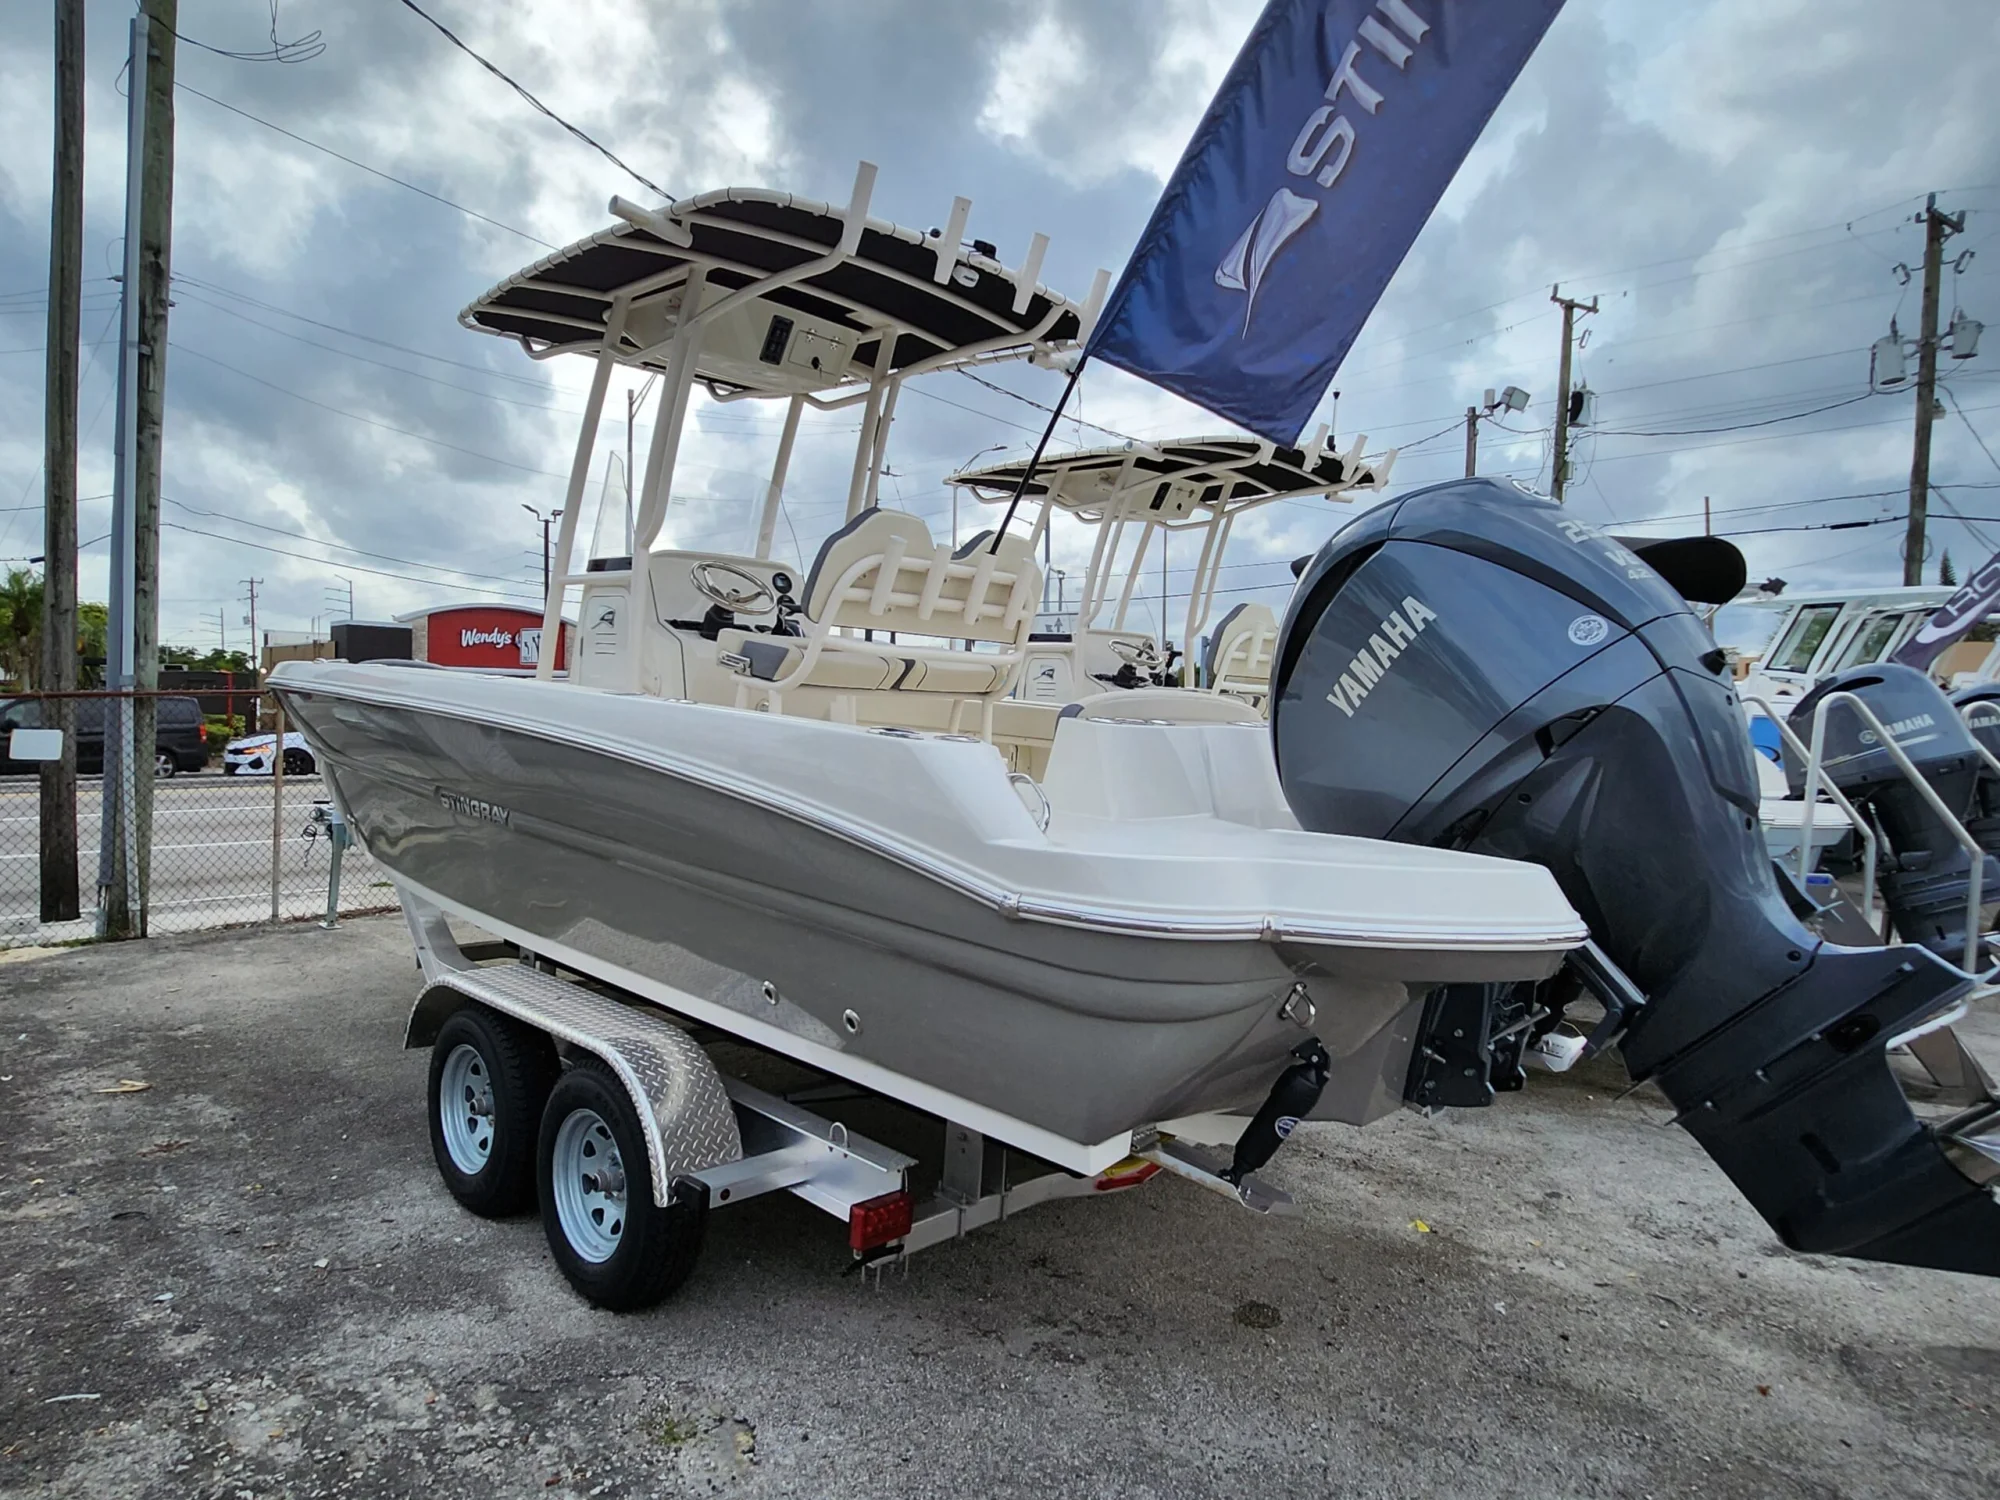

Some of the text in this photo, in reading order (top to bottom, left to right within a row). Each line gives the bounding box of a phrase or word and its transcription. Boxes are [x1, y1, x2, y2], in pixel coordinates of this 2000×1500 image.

[461, 627, 512, 648] Wendy's
[1326, 595, 1437, 718] YAMAHA
[1882, 713, 1936, 736] AMAHA
[440, 791, 510, 825] STINGRAY
